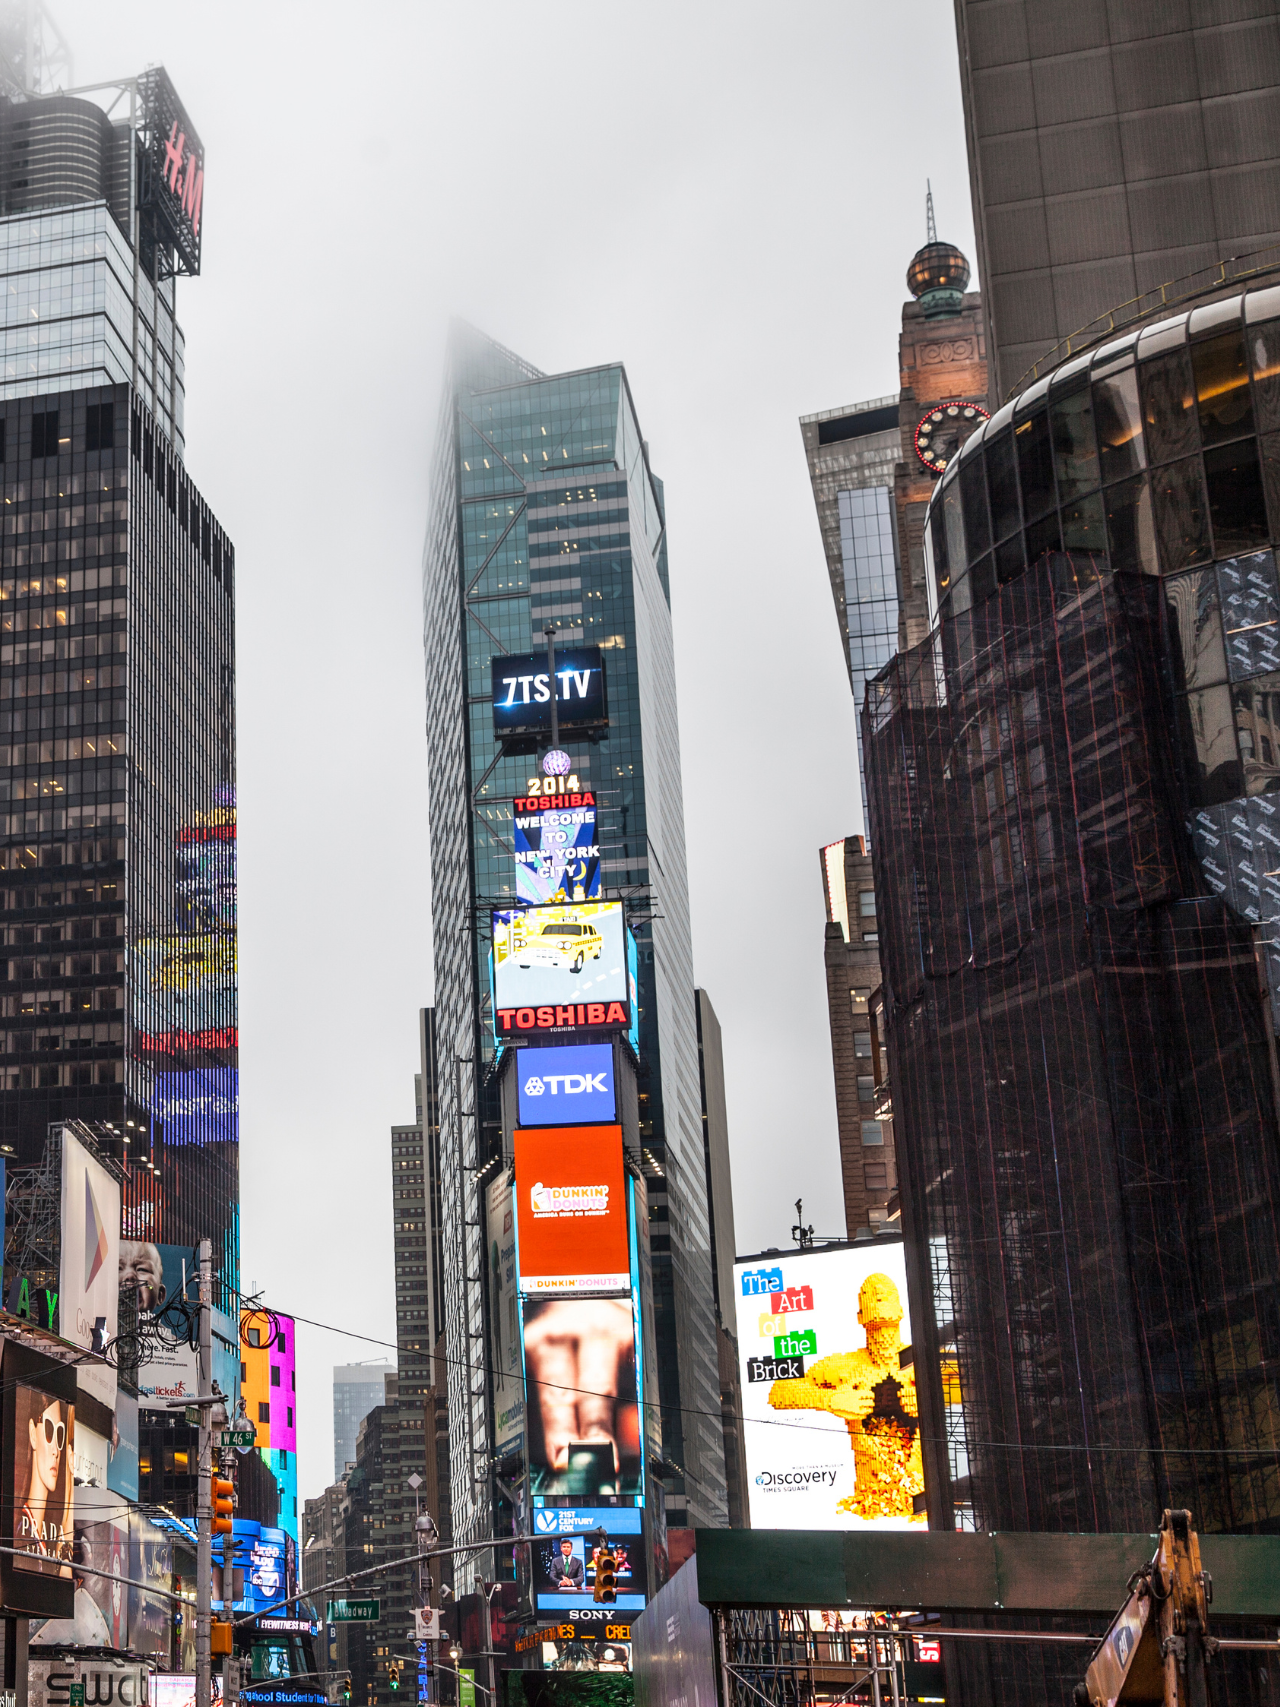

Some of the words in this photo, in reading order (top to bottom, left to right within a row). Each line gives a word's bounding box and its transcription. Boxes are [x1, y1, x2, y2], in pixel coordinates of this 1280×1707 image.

[165, 121, 203, 236] H&M
[502, 669, 590, 705] 7TS.TV
[527, 774, 579, 797] 2014
[514, 792, 595, 812] TOSHIBA
[515, 811, 595, 829] WELCOME
[544, 831, 567, 843] TO
[515, 849, 551, 863] NEW
[555, 845, 600, 860] YORK
[539, 864, 577, 879] CITY
[497, 1002, 626, 1030] TOSHIBA
[542, 1072, 608, 1095] TDK
[552, 1187, 607, 1199] DUNKIN'
[553, 1198, 605, 1209] DONUTS
[537, 1280, 578, 1288] DUNKIN'
[578, 1278, 618, 1287] DONUTS
[743, 1273, 781, 1295] The
[777, 1292, 807, 1312] Art
[763, 1314, 781, 1335] of
[780, 1337, 811, 1356] the
[752, 1360, 799, 1382] Brick
[223, 1432, 231, 1445] W
[232, 1432, 243, 1445] 46
[245, 1432, 252, 1440] ST
[761, 1470, 837, 1487] Discovery
[558, 1510, 576, 1518] 21ST
[21, 1516, 65, 1545] PRADA
[334, 1605, 373, 1618] Broadway
[569, 1610, 615, 1620] SONY
[260, 1619, 299, 1630] EYEWITNESS
